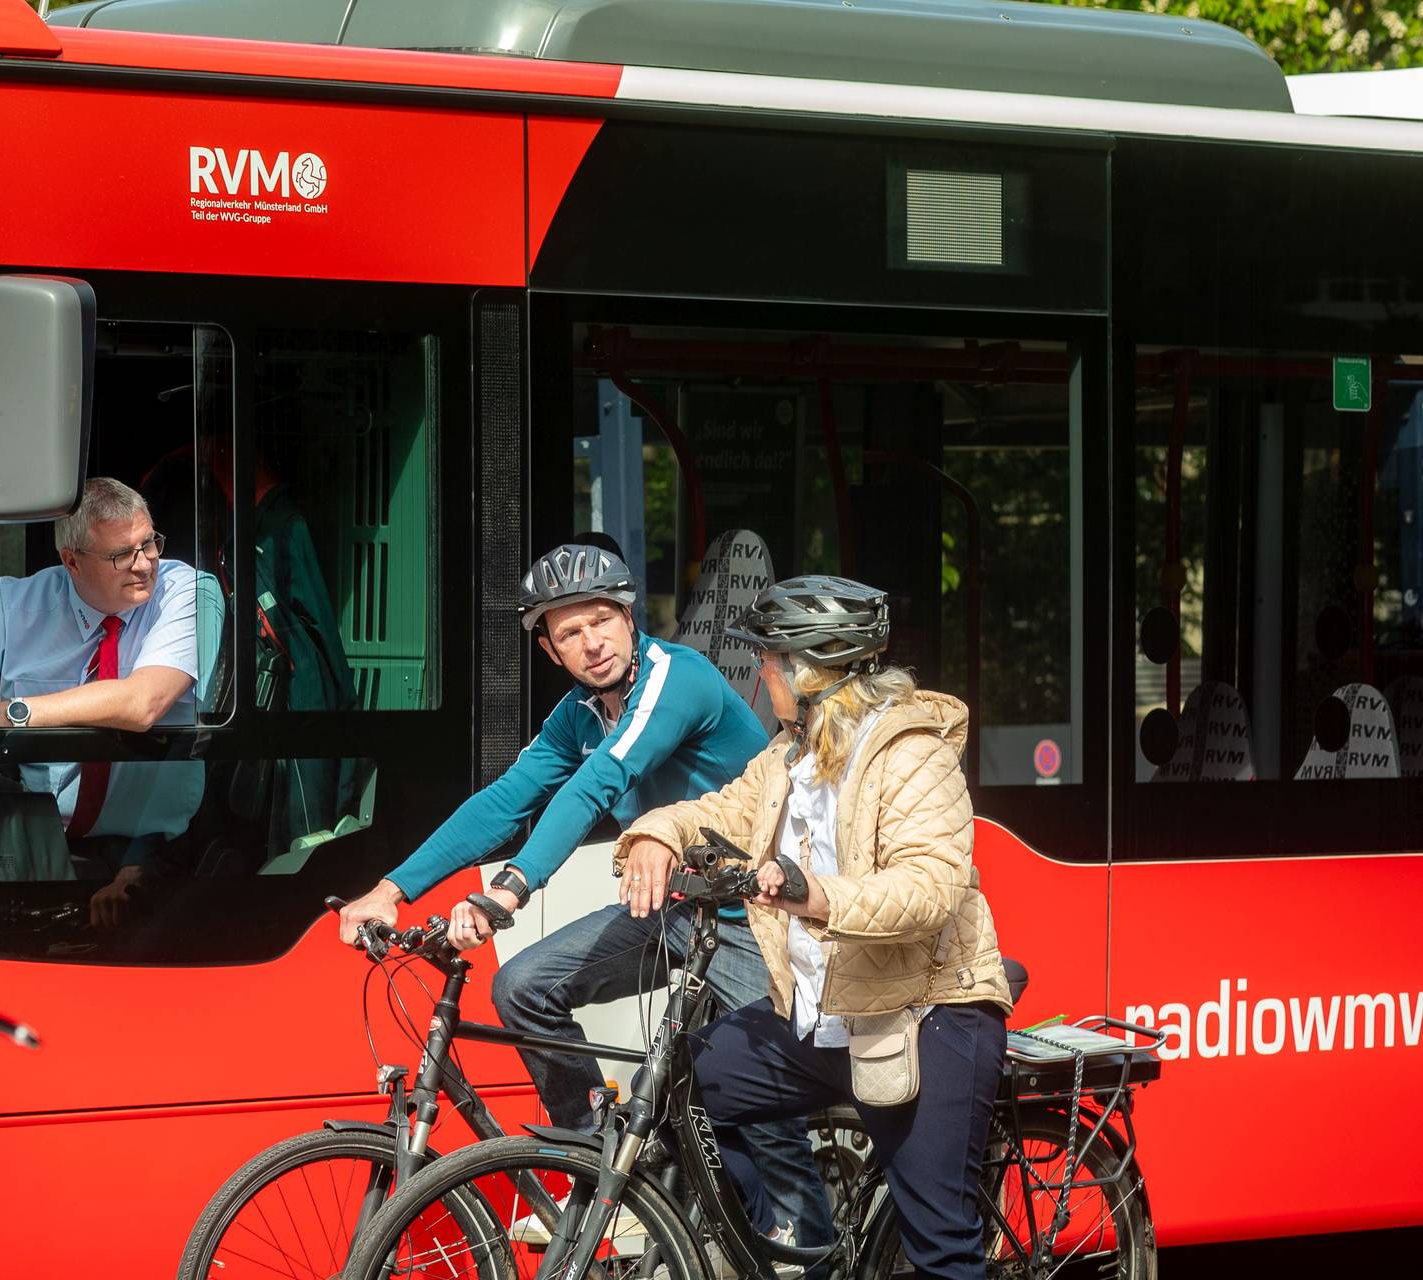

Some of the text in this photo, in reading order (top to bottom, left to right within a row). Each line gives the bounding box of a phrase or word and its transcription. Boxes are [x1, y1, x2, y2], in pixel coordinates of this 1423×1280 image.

[190, 197, 328, 214] Regionalverkehr Münsterland GmbH
[191, 210, 272, 224] Teil der WVG-Gruppe
[1348, 752, 1389, 768] RVM
